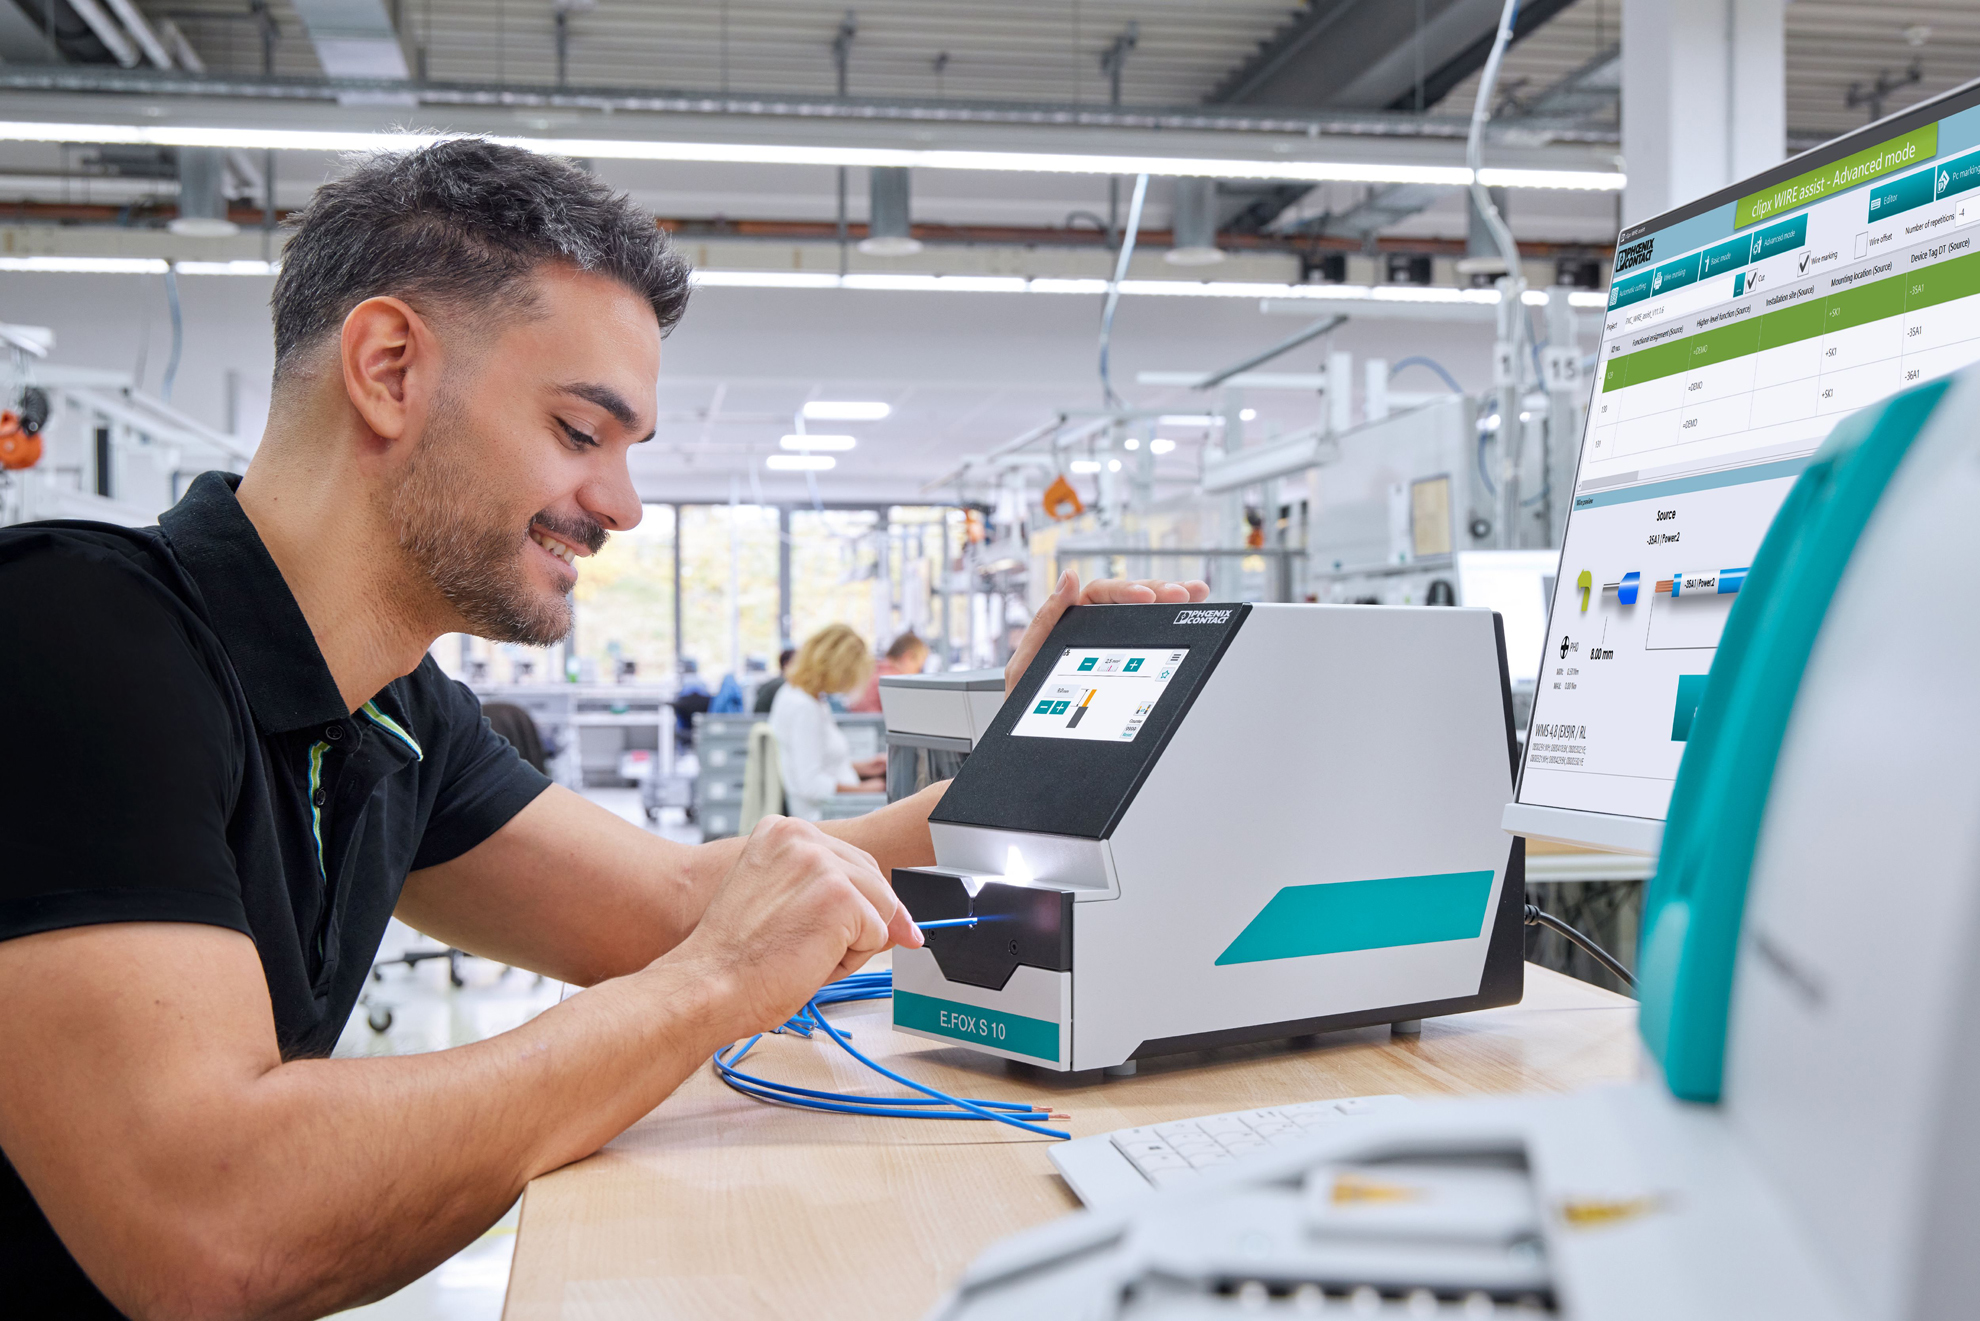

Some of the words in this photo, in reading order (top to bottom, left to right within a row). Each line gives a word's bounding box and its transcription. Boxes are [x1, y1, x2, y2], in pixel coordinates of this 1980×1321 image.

[1752, 198, 1772, 218] clipx
[1774, 186, 1798, 208] WIRE
[1799, 178, 1825, 200] assist
[1833, 153, 1882, 187] Advanced
[1885, 142, 1916, 168] mode
[1884, 194, 1898, 205] Editor
[1905, 224, 1924, 234] Number
[1925, 220, 1930, 228] of
[1930, 214, 1954, 228] repetitions
[1764, 234, 1783, 246] Advanced
[1784, 230, 1795, 239] mode
[1869, 238, 1879, 246] Wire
[1880, 233, 1892, 243] offset
[1811, 256, 1820, 265] Wire
[1821, 251, 1838, 263] marking
[1911, 252, 1928, 263] Device
[1929, 248, 1938, 258] Tag
[1939, 244, 1946, 254] DT
[1948, 238, 1970, 253] (Source)
[1624, 250, 1653, 269] CONTACT
[1831, 273, 1853, 287] Mounting
[1854, 268, 1872, 280] location
[1873, 262, 1892, 276] (Source)
[1766, 293, 1788, 306] Installation
[1789, 291, 1797, 301] site
[1797, 285, 1814, 298] (Source)
[1657, 510, 1676, 521] Source
[1590, 648, 1601, 660] 8.00
[1602, 650, 1613, 660] mm
[1535, 724, 1549, 737] WMS
[940, 1010, 976, 1034] E.FOX
[979, 1020, 988, 1036] S
[992, 1023, 1006, 1040] 10
